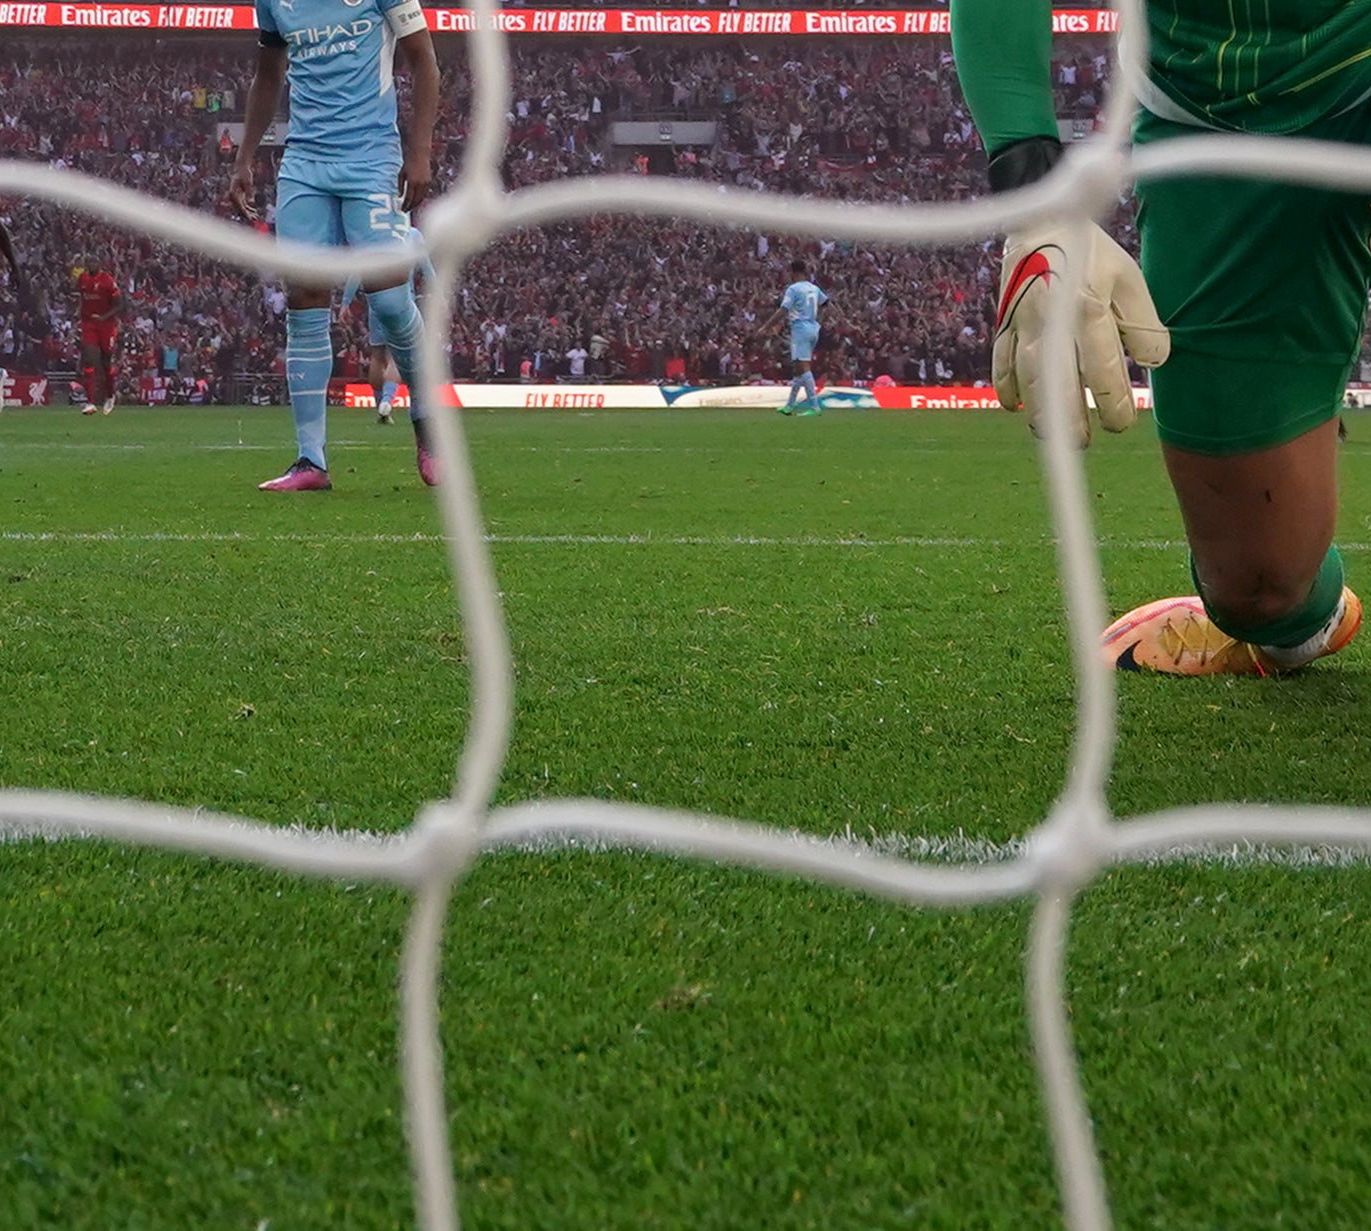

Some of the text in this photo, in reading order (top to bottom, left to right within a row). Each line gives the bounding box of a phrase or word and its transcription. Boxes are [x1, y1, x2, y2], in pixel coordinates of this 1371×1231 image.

[61, 5, 233, 27] Emirates FLY BETTER
[436, 10, 525, 32] Emiates
[533, 12, 557, 31] FLY
[558, 12, 606, 31] BETTER
[621, 11, 791, 33] Emirates FLY BETTER
[806, 12, 896, 33] Emirates
[904, 14, 928, 32] FLY
[1096, 12, 1119, 32] FLY
[297, 39, 357, 59] AIRWAYS
[368, 193, 411, 232] 25
[526, 393, 605, 408] FLY BETTER
[910, 395, 1001, 409] Emirate
